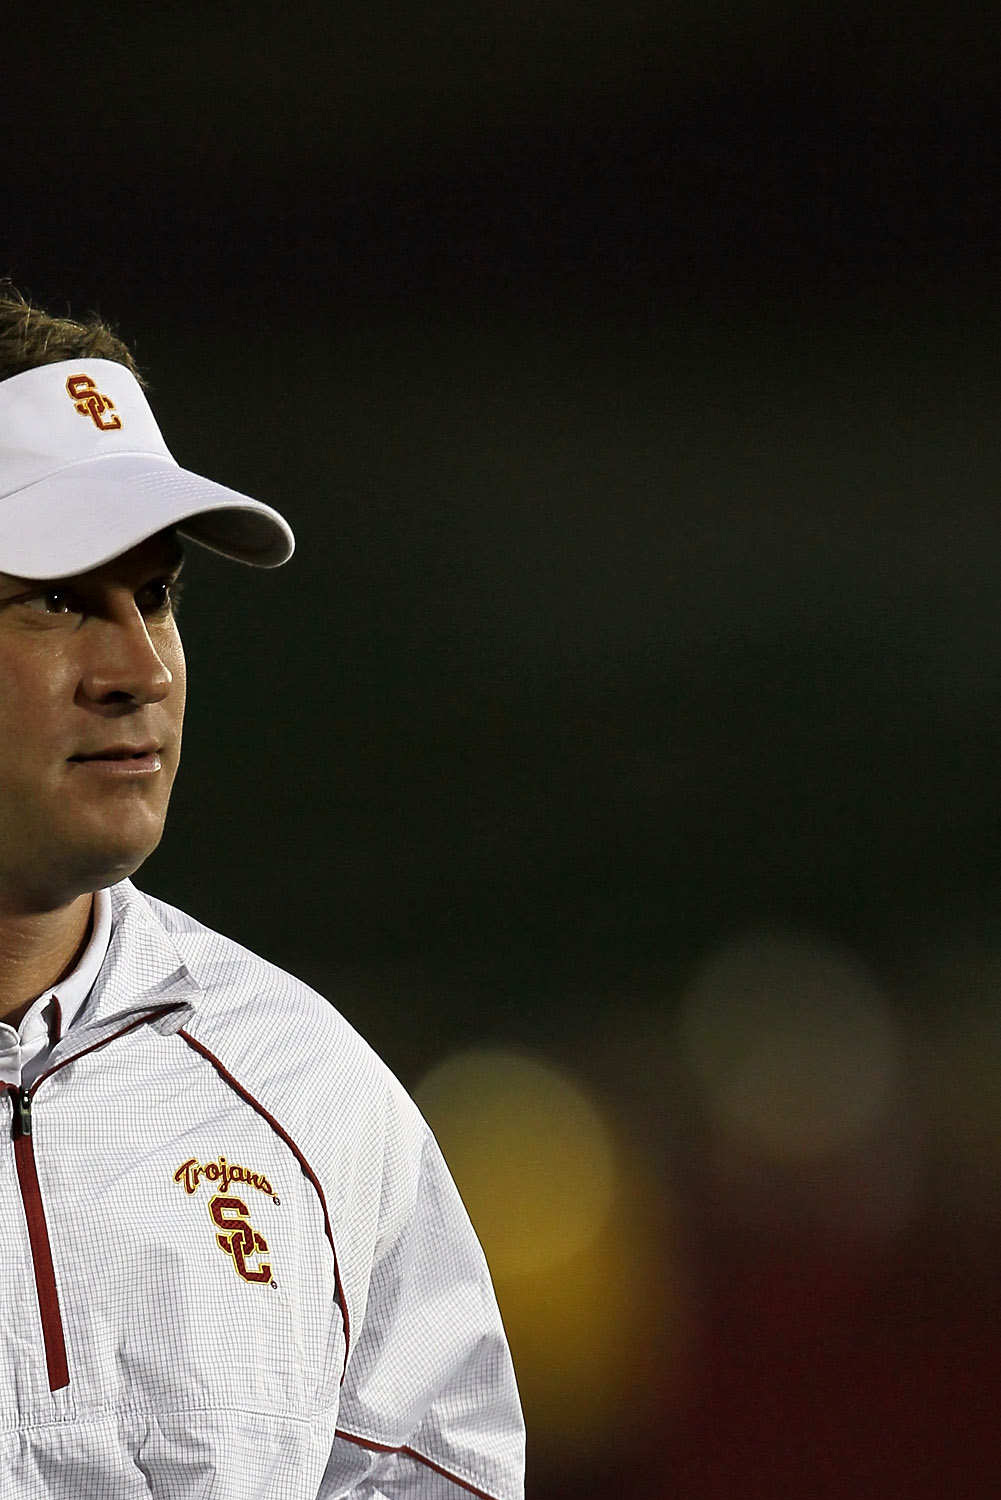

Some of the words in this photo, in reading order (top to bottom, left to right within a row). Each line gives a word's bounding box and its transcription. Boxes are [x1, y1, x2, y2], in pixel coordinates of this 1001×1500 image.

[66, 373, 123, 431] SC
[174, 1156, 277, 1196] Trojans
[208, 1195, 273, 1286] SC
